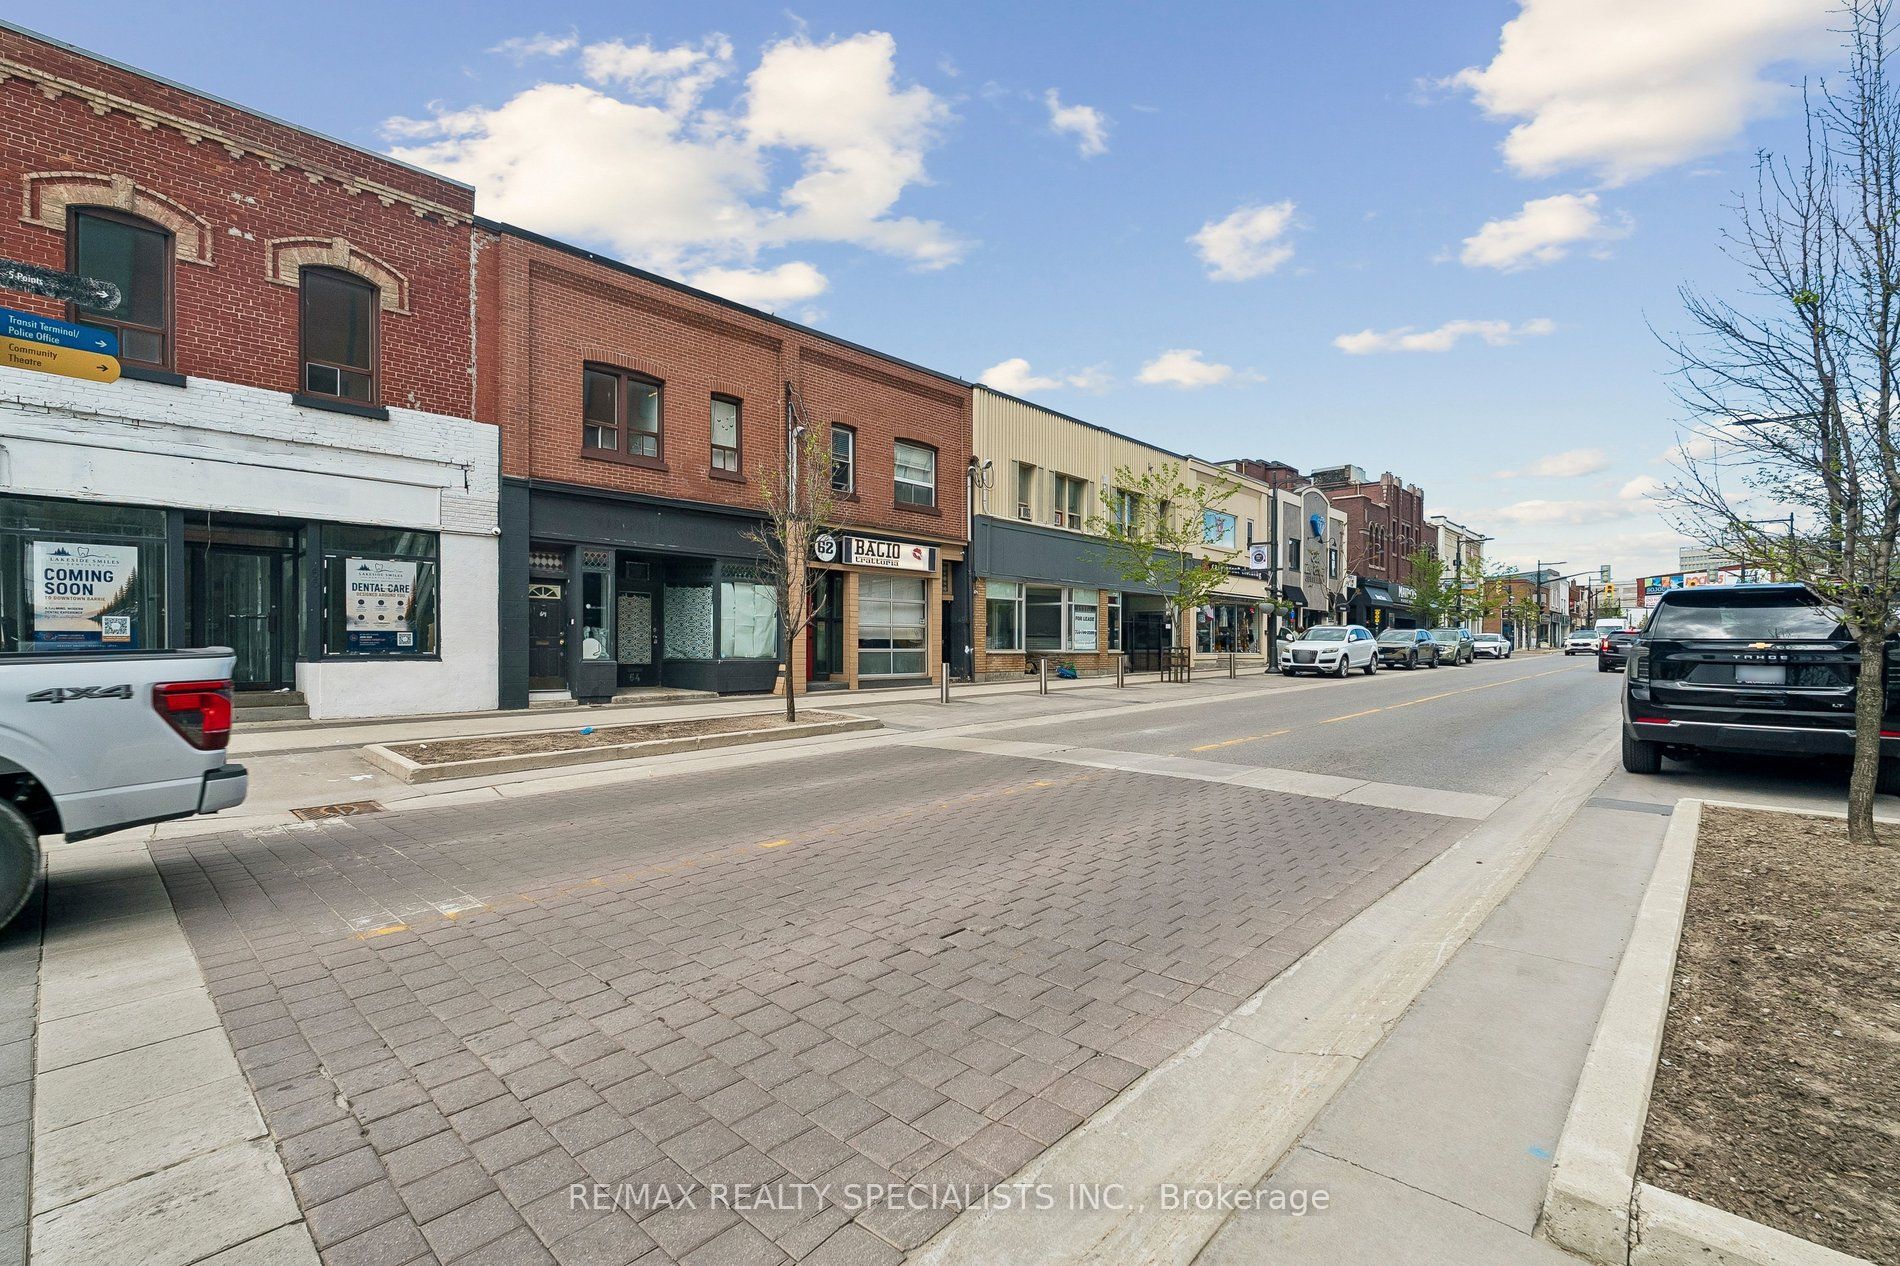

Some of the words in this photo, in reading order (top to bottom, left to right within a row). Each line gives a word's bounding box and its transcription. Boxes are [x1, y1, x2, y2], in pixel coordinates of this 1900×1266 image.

[16, 273, 43, 285] Points
[8, 314, 37, 329] Transit
[40, 322, 80, 339] Terminal/
[8, 326, 33, 339] Police
[36, 332, 60, 344] Office
[8, 343, 58, 360] Community
[8, 354, 42, 367] Theatre
[818, 540, 834, 554] 62
[854, 538, 901, 559] BACIO
[855, 556, 900, 567] trattoria
[44, 568, 114, 583] COMING
[44, 582, 94, 596] SOON
[351, 582, 386, 592] DENTAL
[387, 583, 410, 593] CARE
